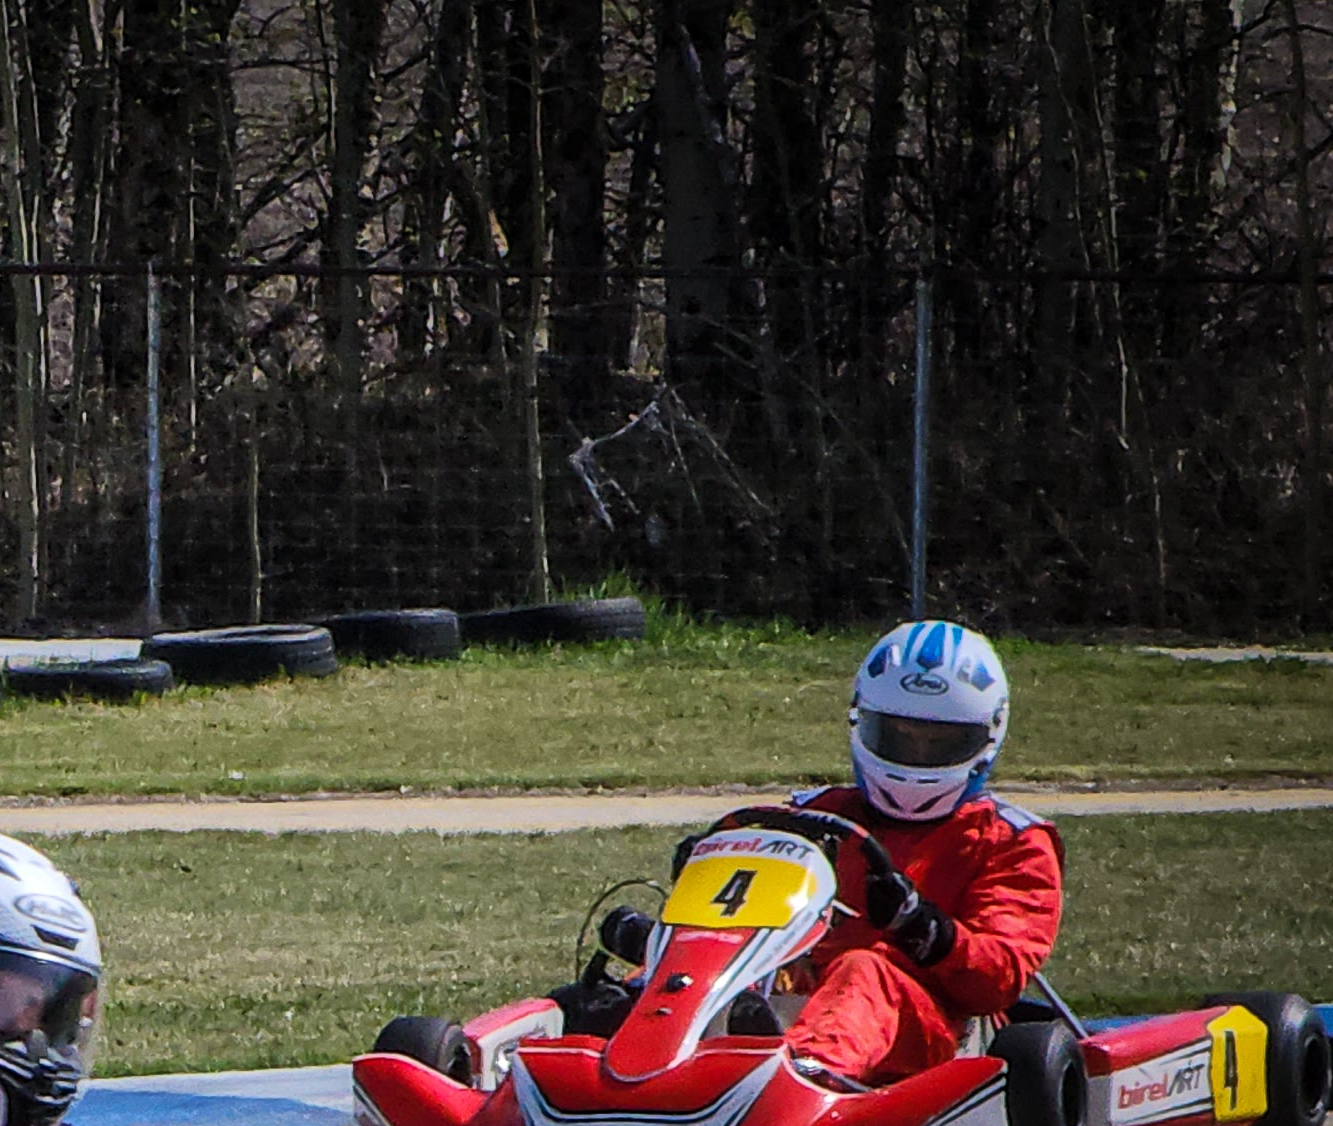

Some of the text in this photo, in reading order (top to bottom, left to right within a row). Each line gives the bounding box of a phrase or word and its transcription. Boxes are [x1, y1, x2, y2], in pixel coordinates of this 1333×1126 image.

[709, 869, 758, 917] 4
[1117, 1060, 1205, 1109] birelART
[1223, 1030, 1239, 1112] 4
